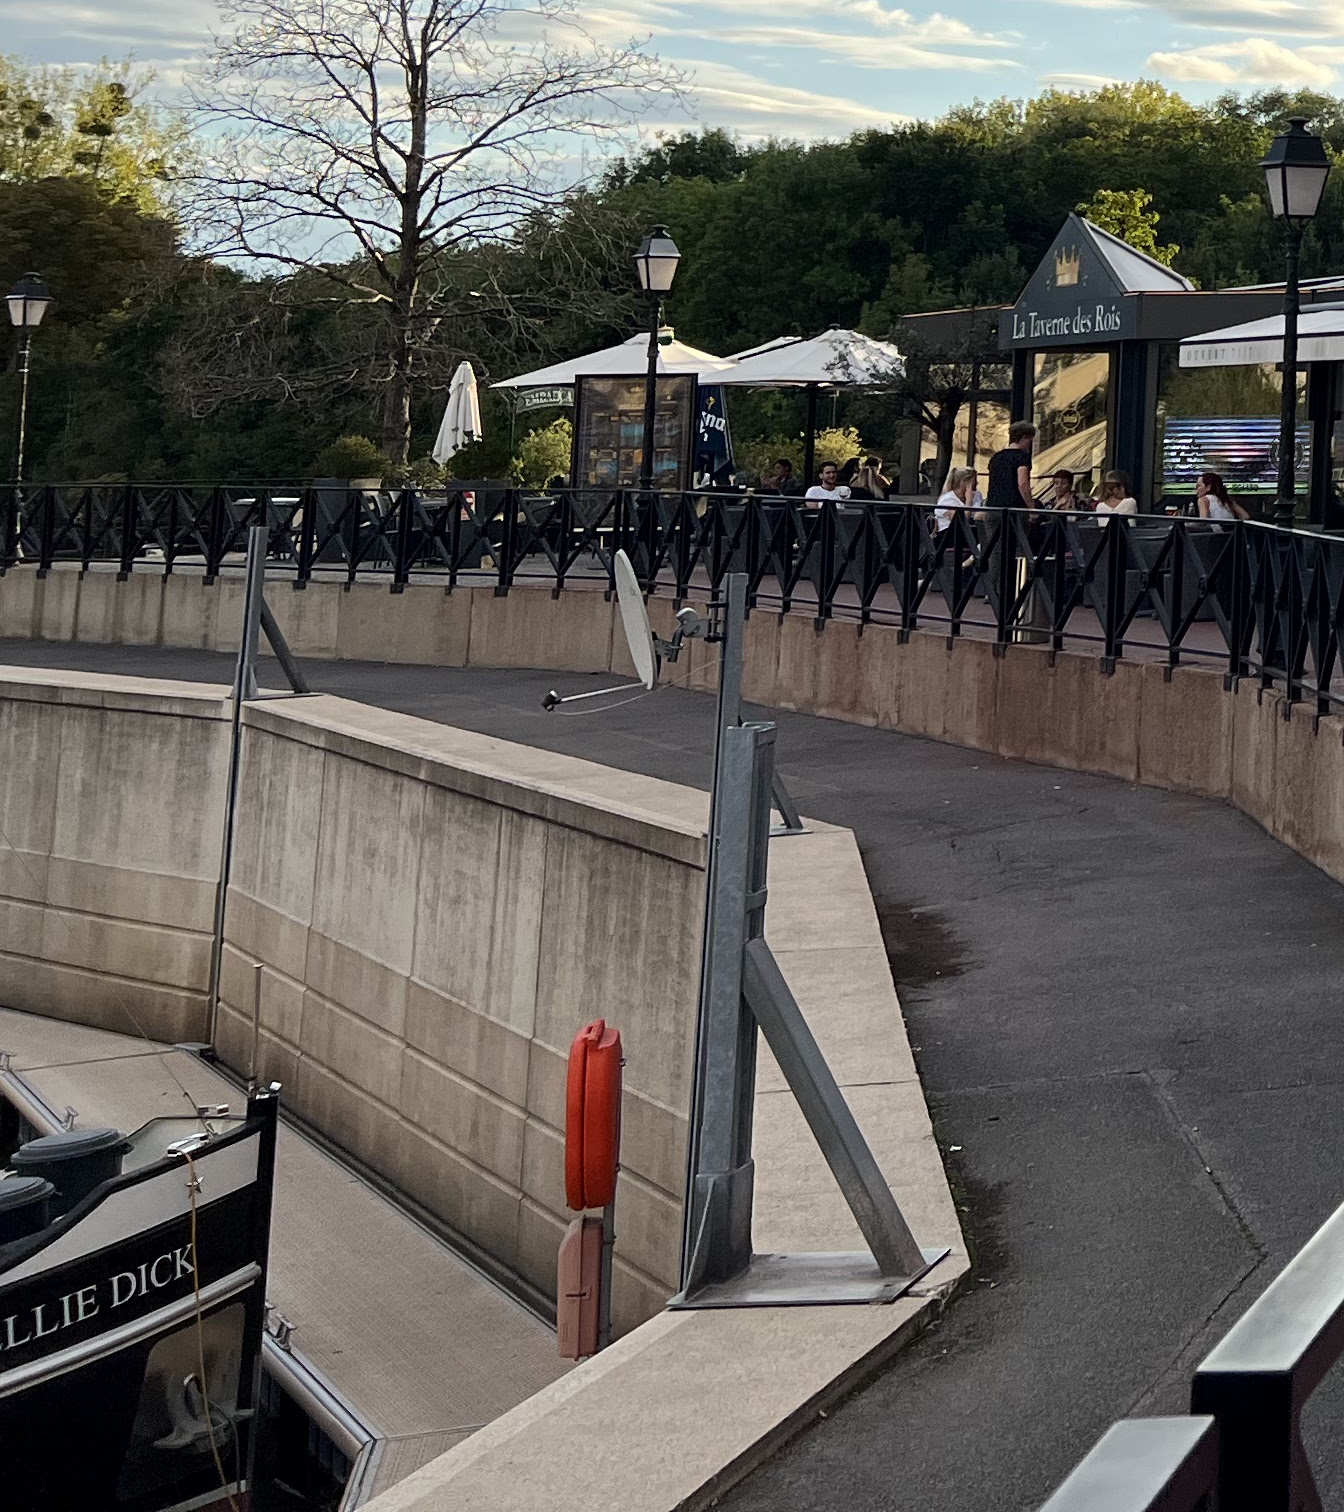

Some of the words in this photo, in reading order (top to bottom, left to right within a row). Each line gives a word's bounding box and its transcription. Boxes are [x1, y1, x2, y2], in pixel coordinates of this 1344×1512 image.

[1011, 313, 1026, 340] La
[1028, 311, 1071, 338] Taverne
[1071, 305, 1092, 334] des
[1094, 304, 1121, 332] Rois
[0, 1284, 100, 1351] LLIE
[108, 1243, 195, 1308] DICK
